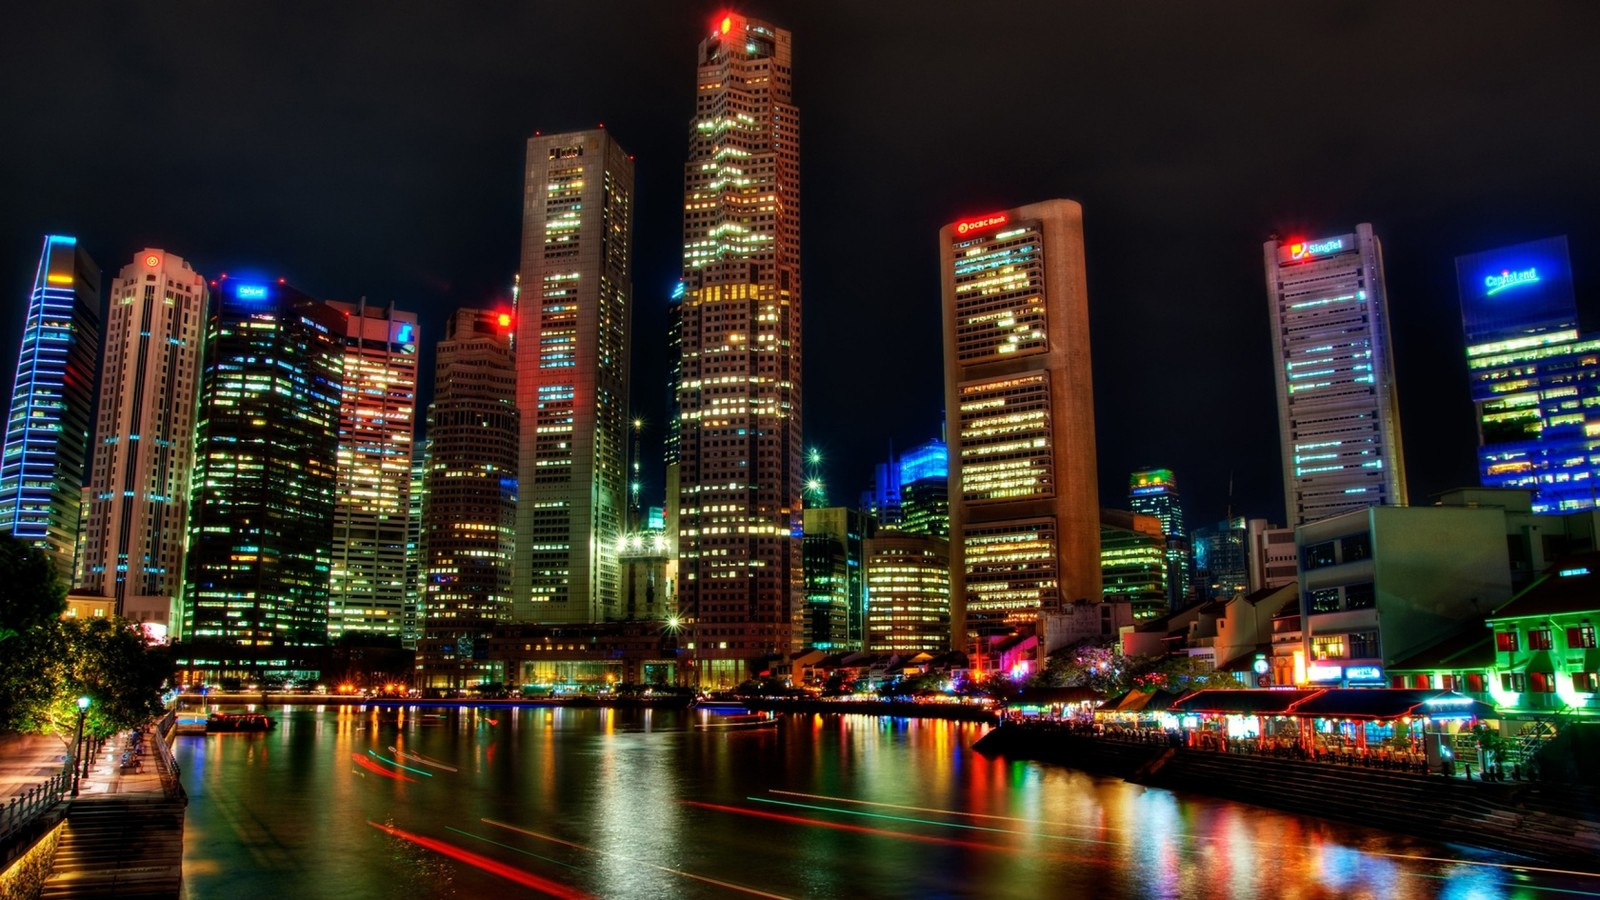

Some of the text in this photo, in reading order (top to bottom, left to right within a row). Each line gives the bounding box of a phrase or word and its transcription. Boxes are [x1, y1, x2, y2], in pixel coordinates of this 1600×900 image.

[969, 215, 1006, 230] OCBC Bank
[1309, 239, 1342, 254] SingTel
